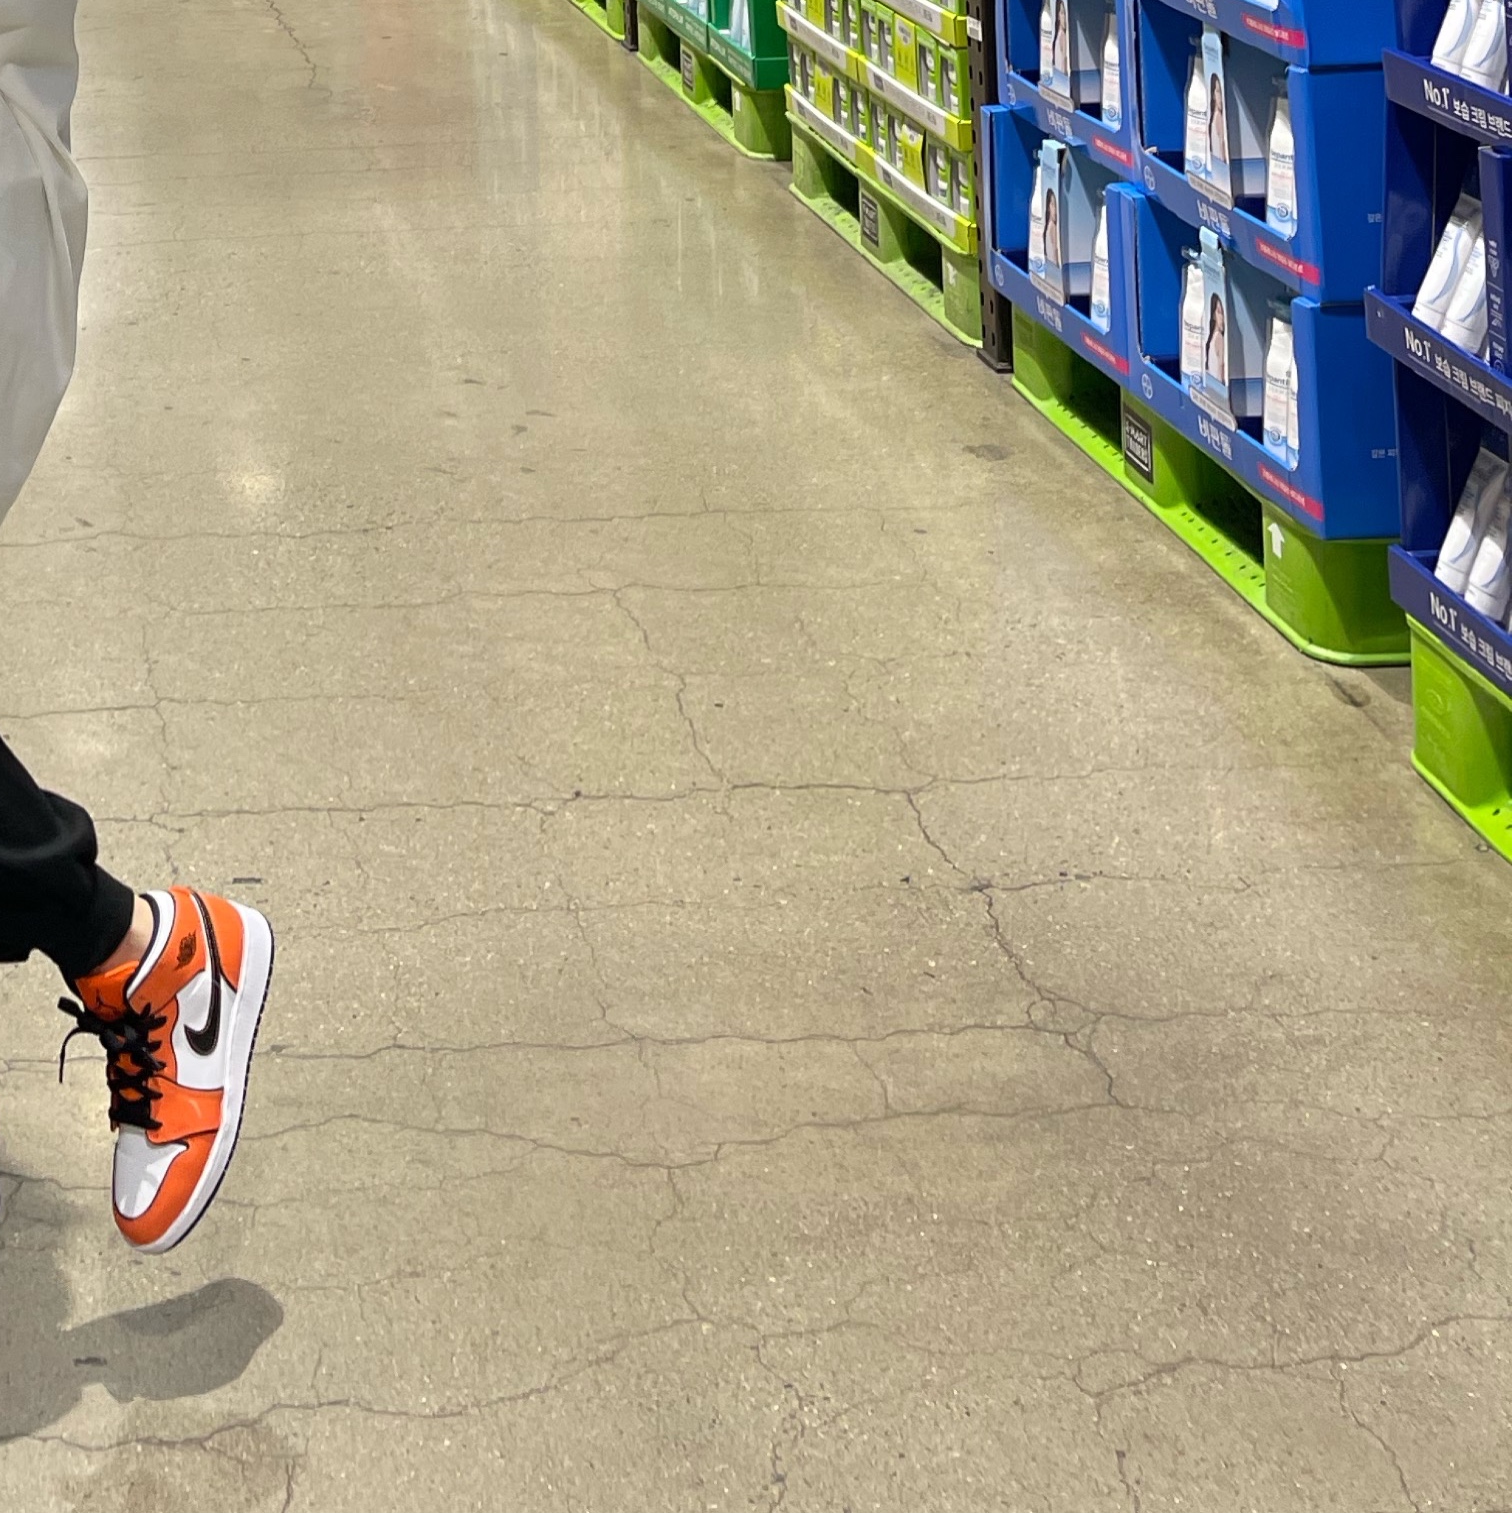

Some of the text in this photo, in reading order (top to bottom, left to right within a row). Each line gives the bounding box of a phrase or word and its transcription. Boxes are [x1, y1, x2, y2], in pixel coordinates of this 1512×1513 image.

[1046, 109, 1073, 137] 비판톨
[1453, 99, 1470, 121] 보습
[1471, 105, 1487, 129] 크림
[1488, 112, 1512, 138] 브랜드
[1197, 198, 1230, 236] 비판톨
[1036, 296, 1062, 333] 비판톨
[1434, 352, 1451, 378] 보습
[1452, 364, 1469, 390] 크림
[1469, 374, 1495, 407] 브랜드
[1197, 414, 1233, 461] 비판톨
[1460, 622, 1477, 649] 보습
[1478, 636, 1495, 667] 크림
